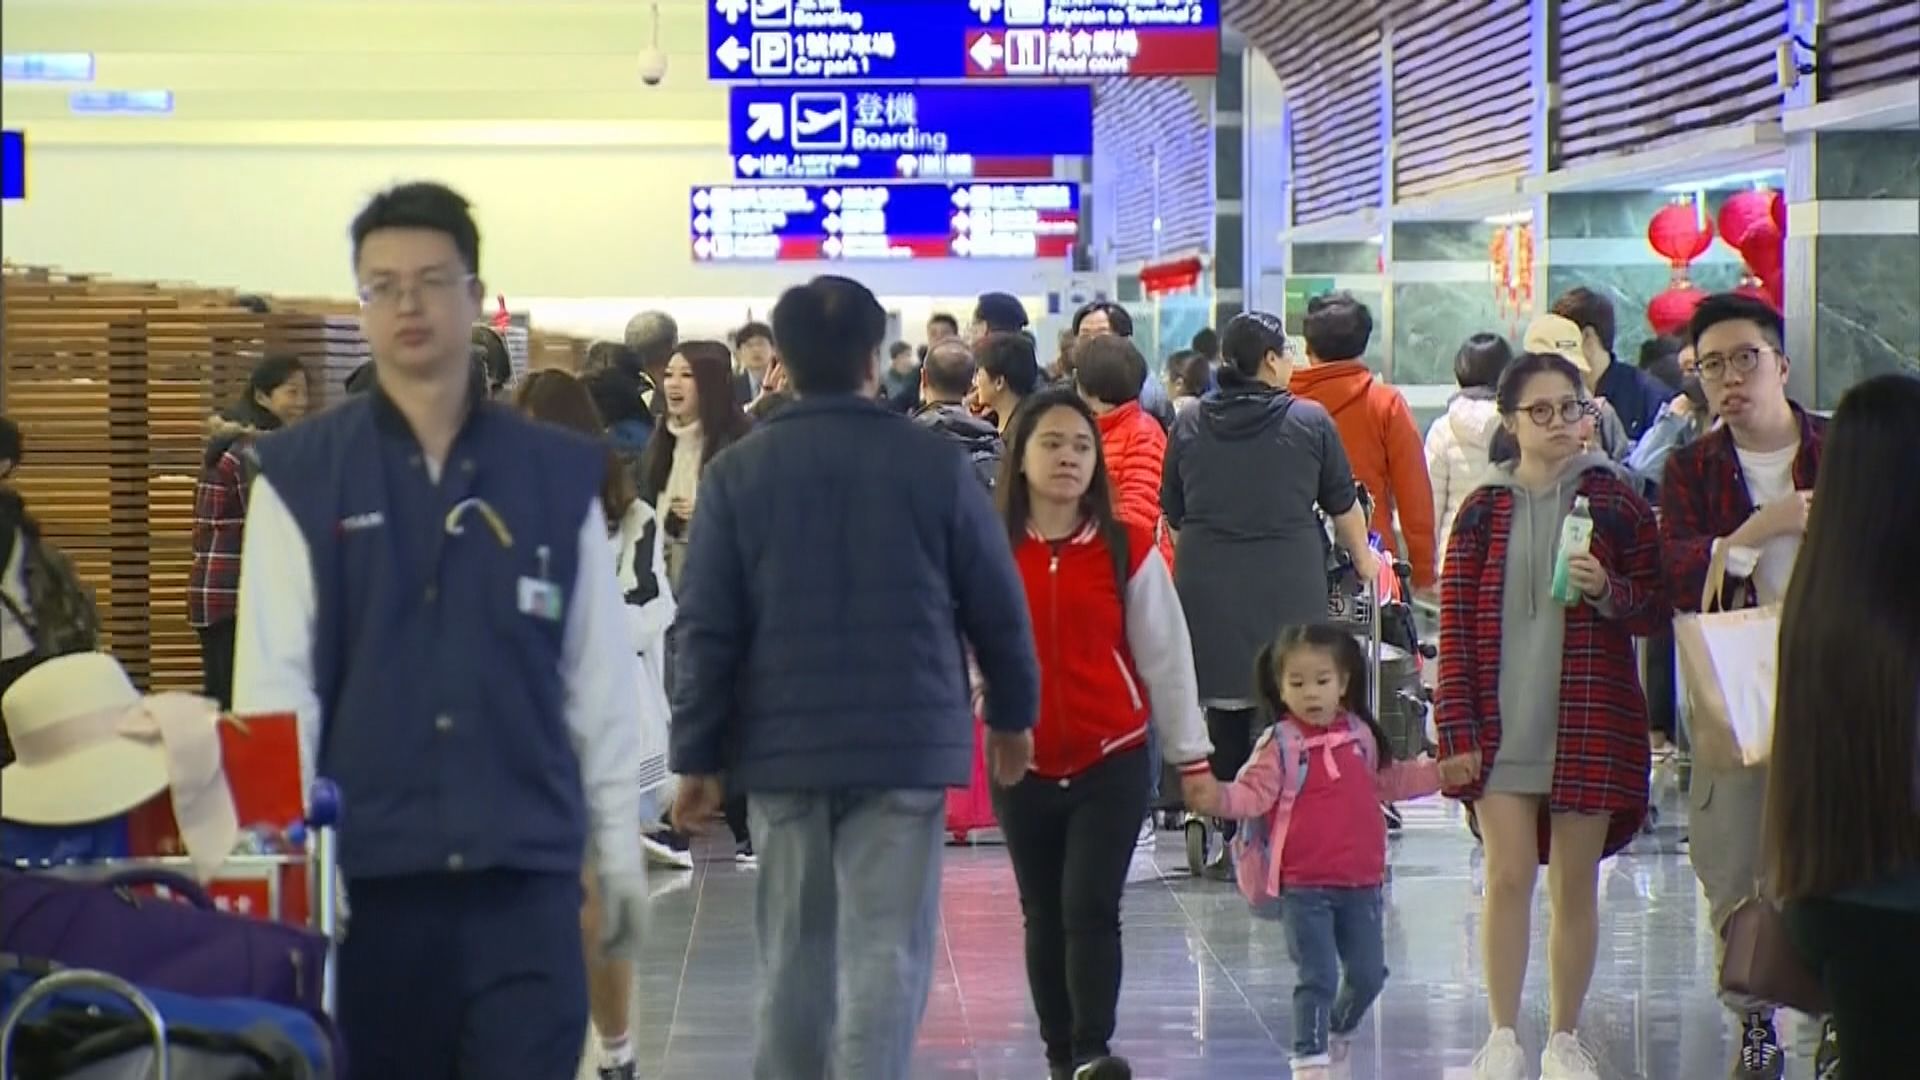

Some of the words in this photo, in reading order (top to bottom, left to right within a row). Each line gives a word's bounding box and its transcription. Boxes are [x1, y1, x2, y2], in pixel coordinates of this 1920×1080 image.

[1192, 5, 1202, 23] 2
[795, 56, 821, 73] Car
[824, 57, 857, 76] park
[862, 56, 869, 73] 1
[1048, 54, 1087, 73] Food
[1089, 56, 1128, 73] court
[853, 93, 917, 126] 登機
[852, 128, 947, 152] Boarding
